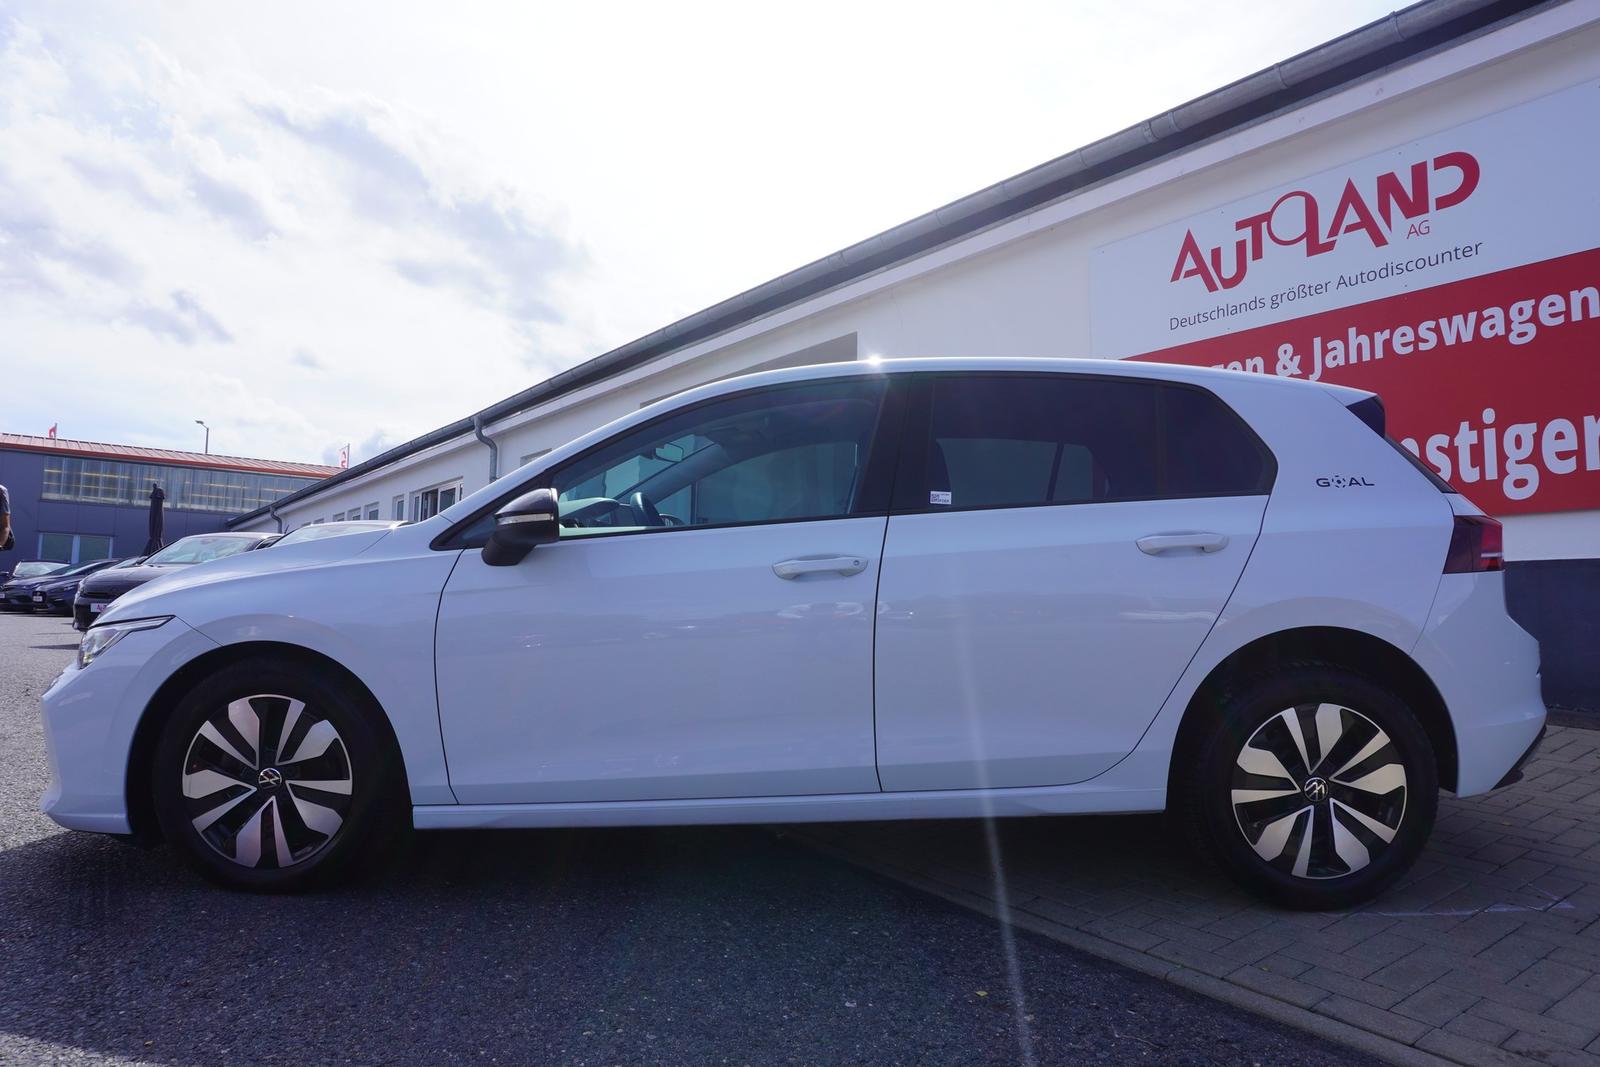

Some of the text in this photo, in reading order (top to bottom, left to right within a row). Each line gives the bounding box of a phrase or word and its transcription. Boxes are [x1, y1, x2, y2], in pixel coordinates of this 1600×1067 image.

[1170, 151, 1480, 293] AUTOLAND
[1406, 220, 1430, 240] AG
[1169, 241, 1483, 331] Deutschlands größter Autodiscounter
[1276, 343, 1302, 376] &
[1309, 286, 1600, 381] Jahreswagen
